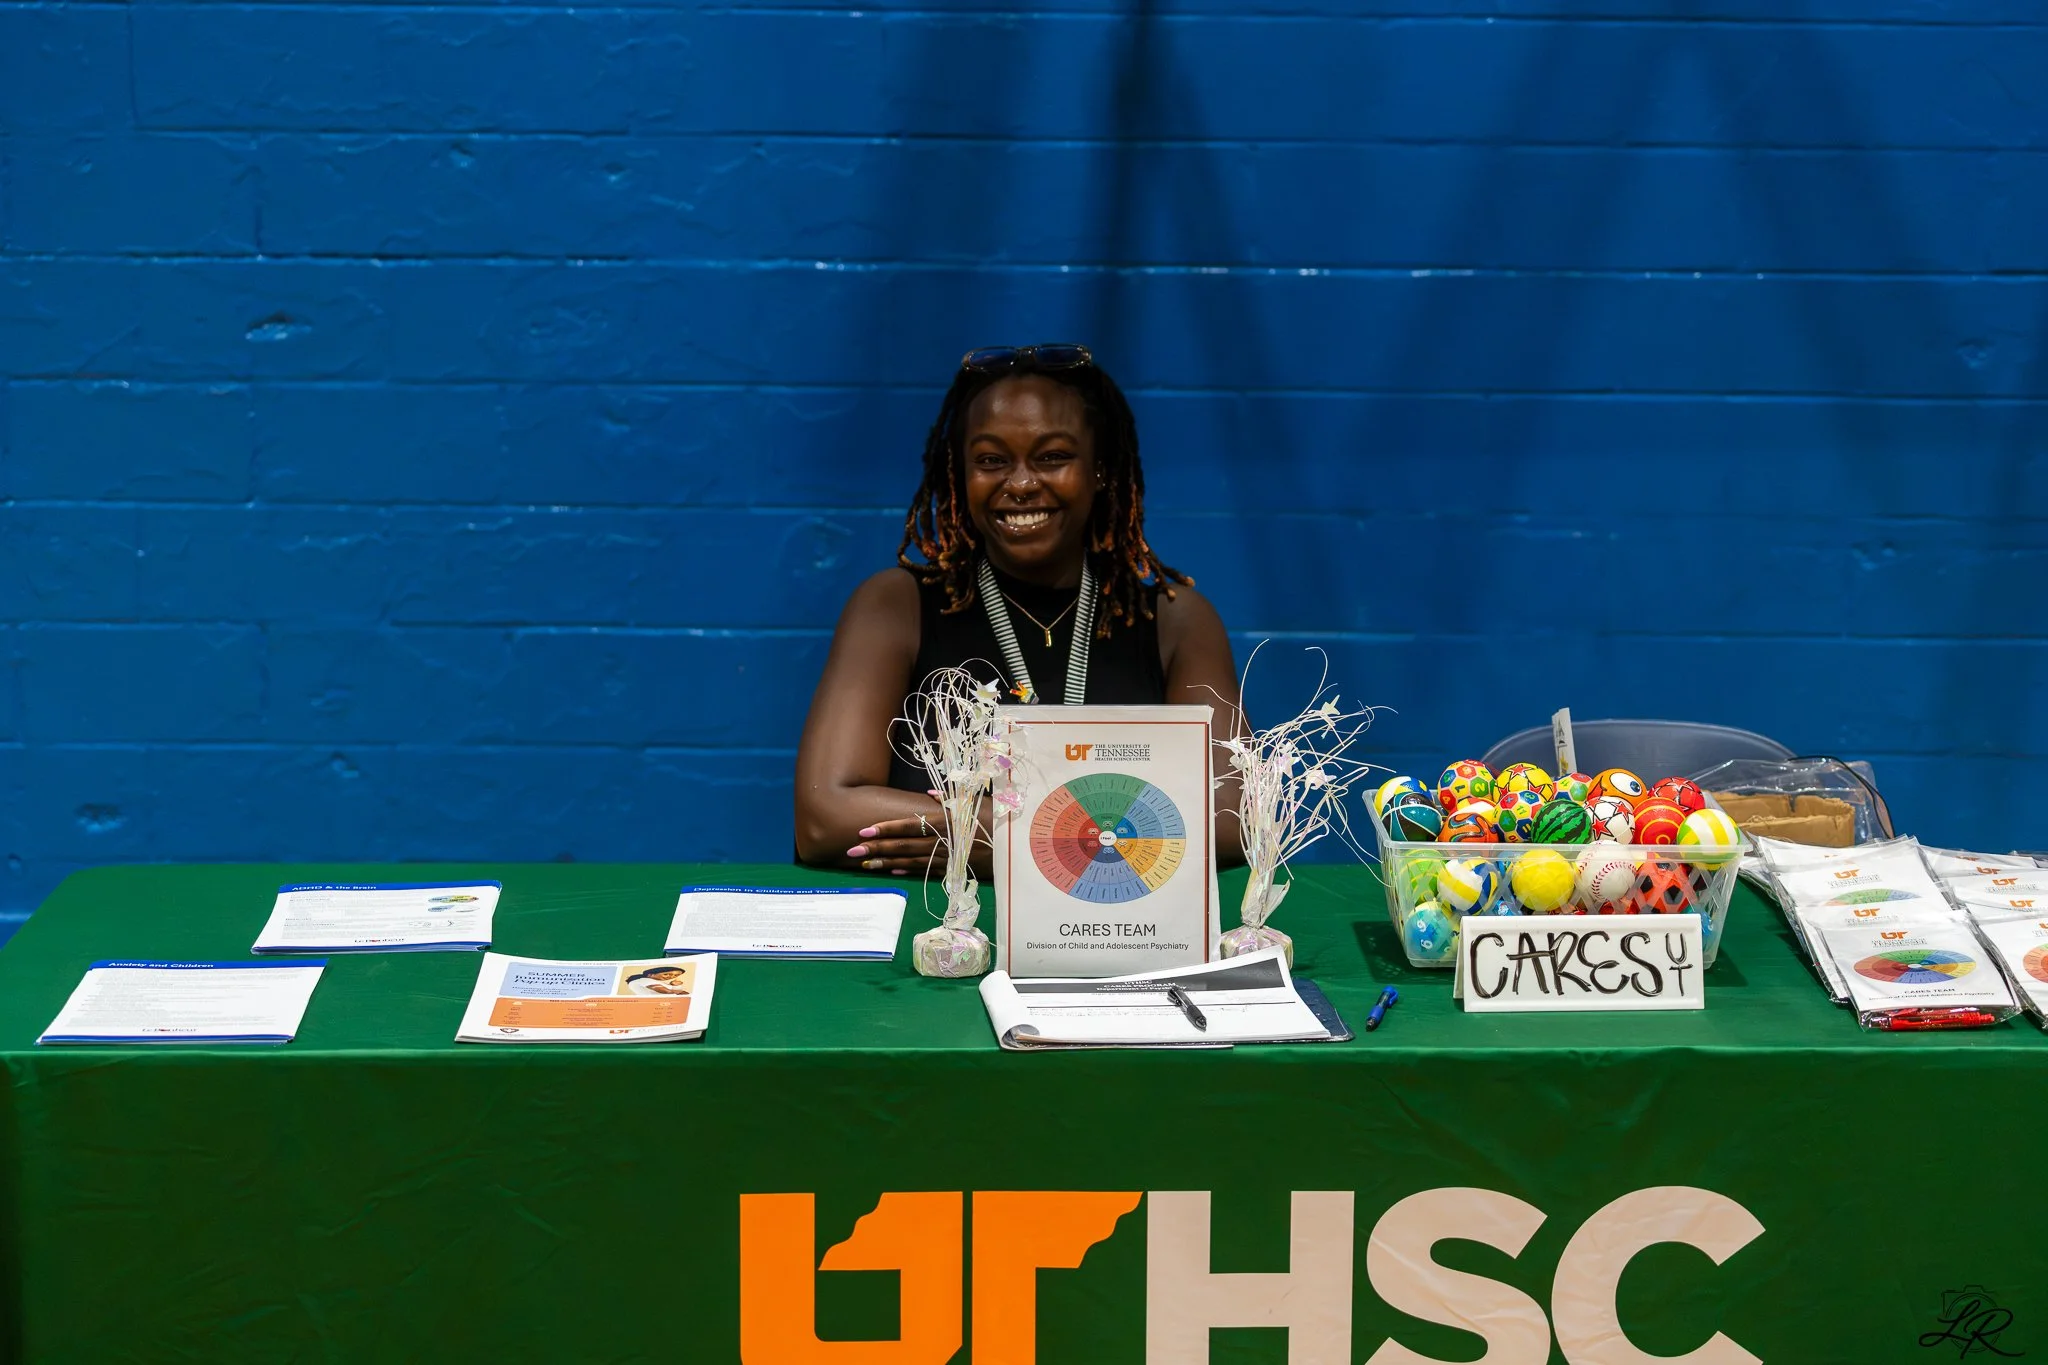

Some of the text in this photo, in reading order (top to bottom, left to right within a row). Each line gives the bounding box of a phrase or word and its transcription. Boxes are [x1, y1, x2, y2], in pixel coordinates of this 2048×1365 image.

[1065, 744, 1094, 761] UT
[1095, 749, 1151, 757] TENNESSEE
[1474, 782, 1485, 792] 2
[1059, 923, 1156, 936] CARES TEAM
[1150, 942, 1189, 951] Psychiatry
[1470, 930, 1664, 998] CARES
[740, 1186, 1764, 1365] UTHSC
